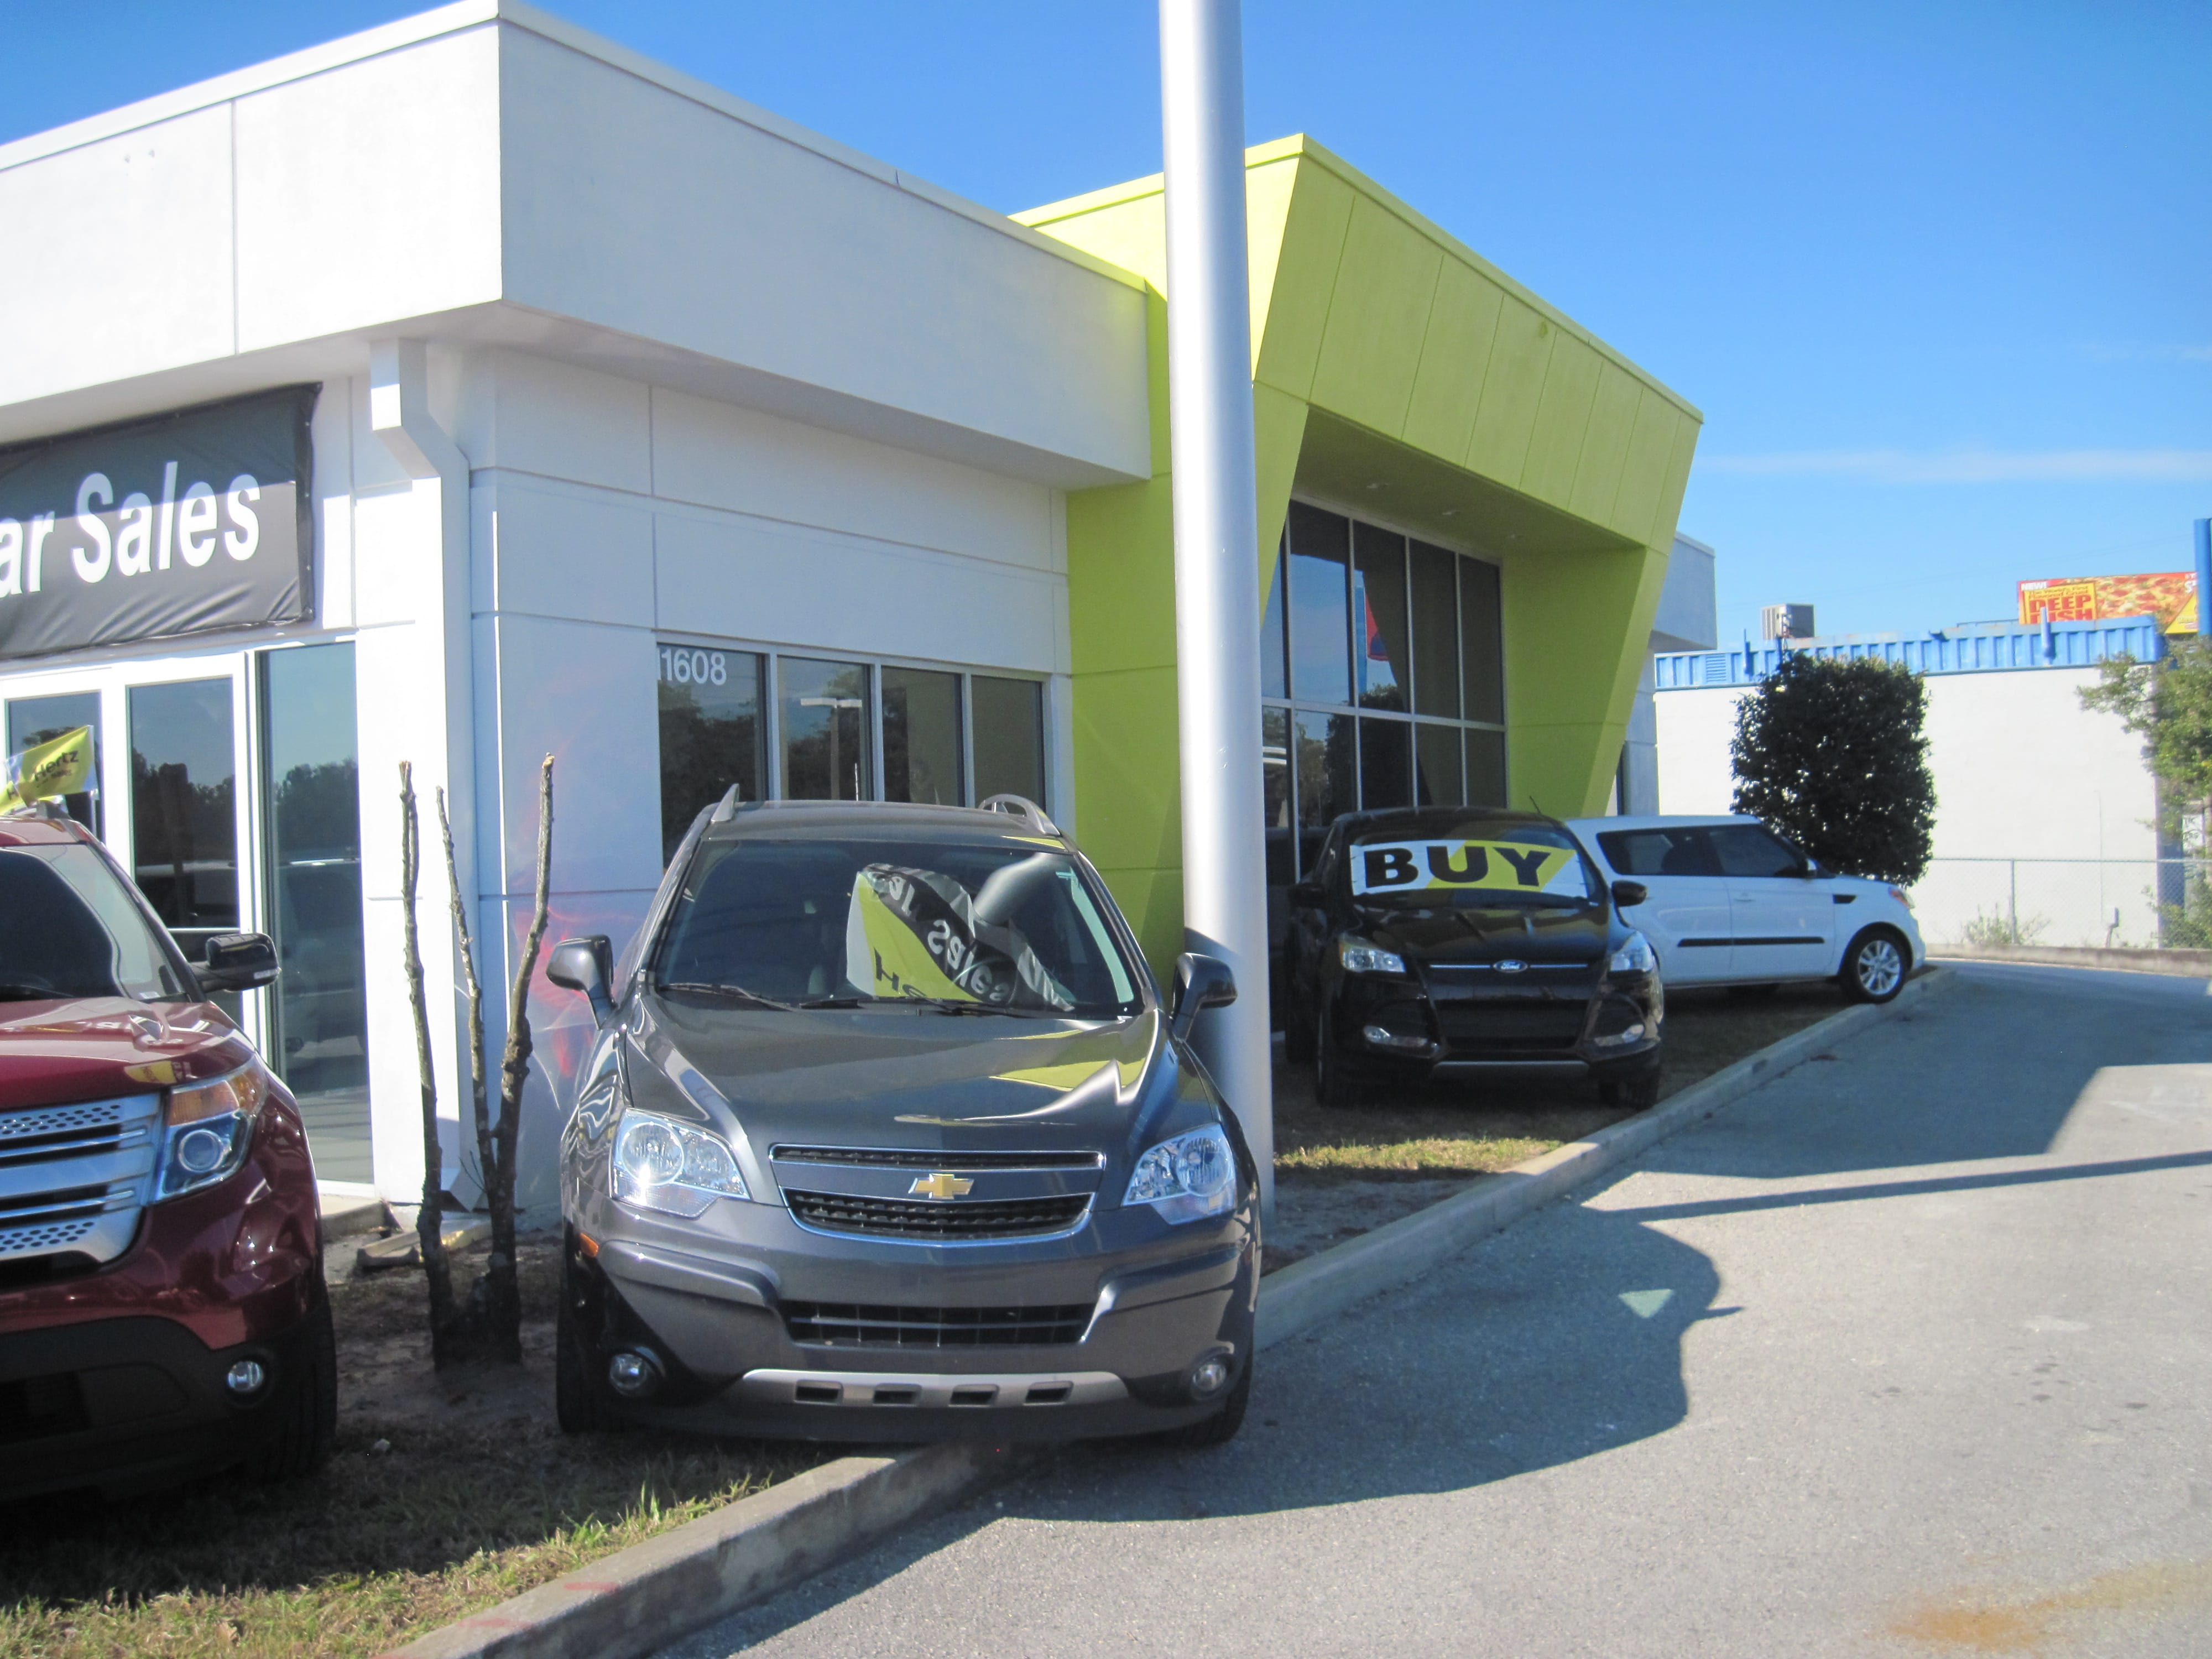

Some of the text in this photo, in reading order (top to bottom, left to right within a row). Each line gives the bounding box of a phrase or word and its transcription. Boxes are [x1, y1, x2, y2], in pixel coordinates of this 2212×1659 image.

[72, 461, 260, 583] Sales
[2030, 594, 2091, 613] DEEP
[35, 750, 79, 781] Hertz
[1363, 846, 1551, 889] BUY
